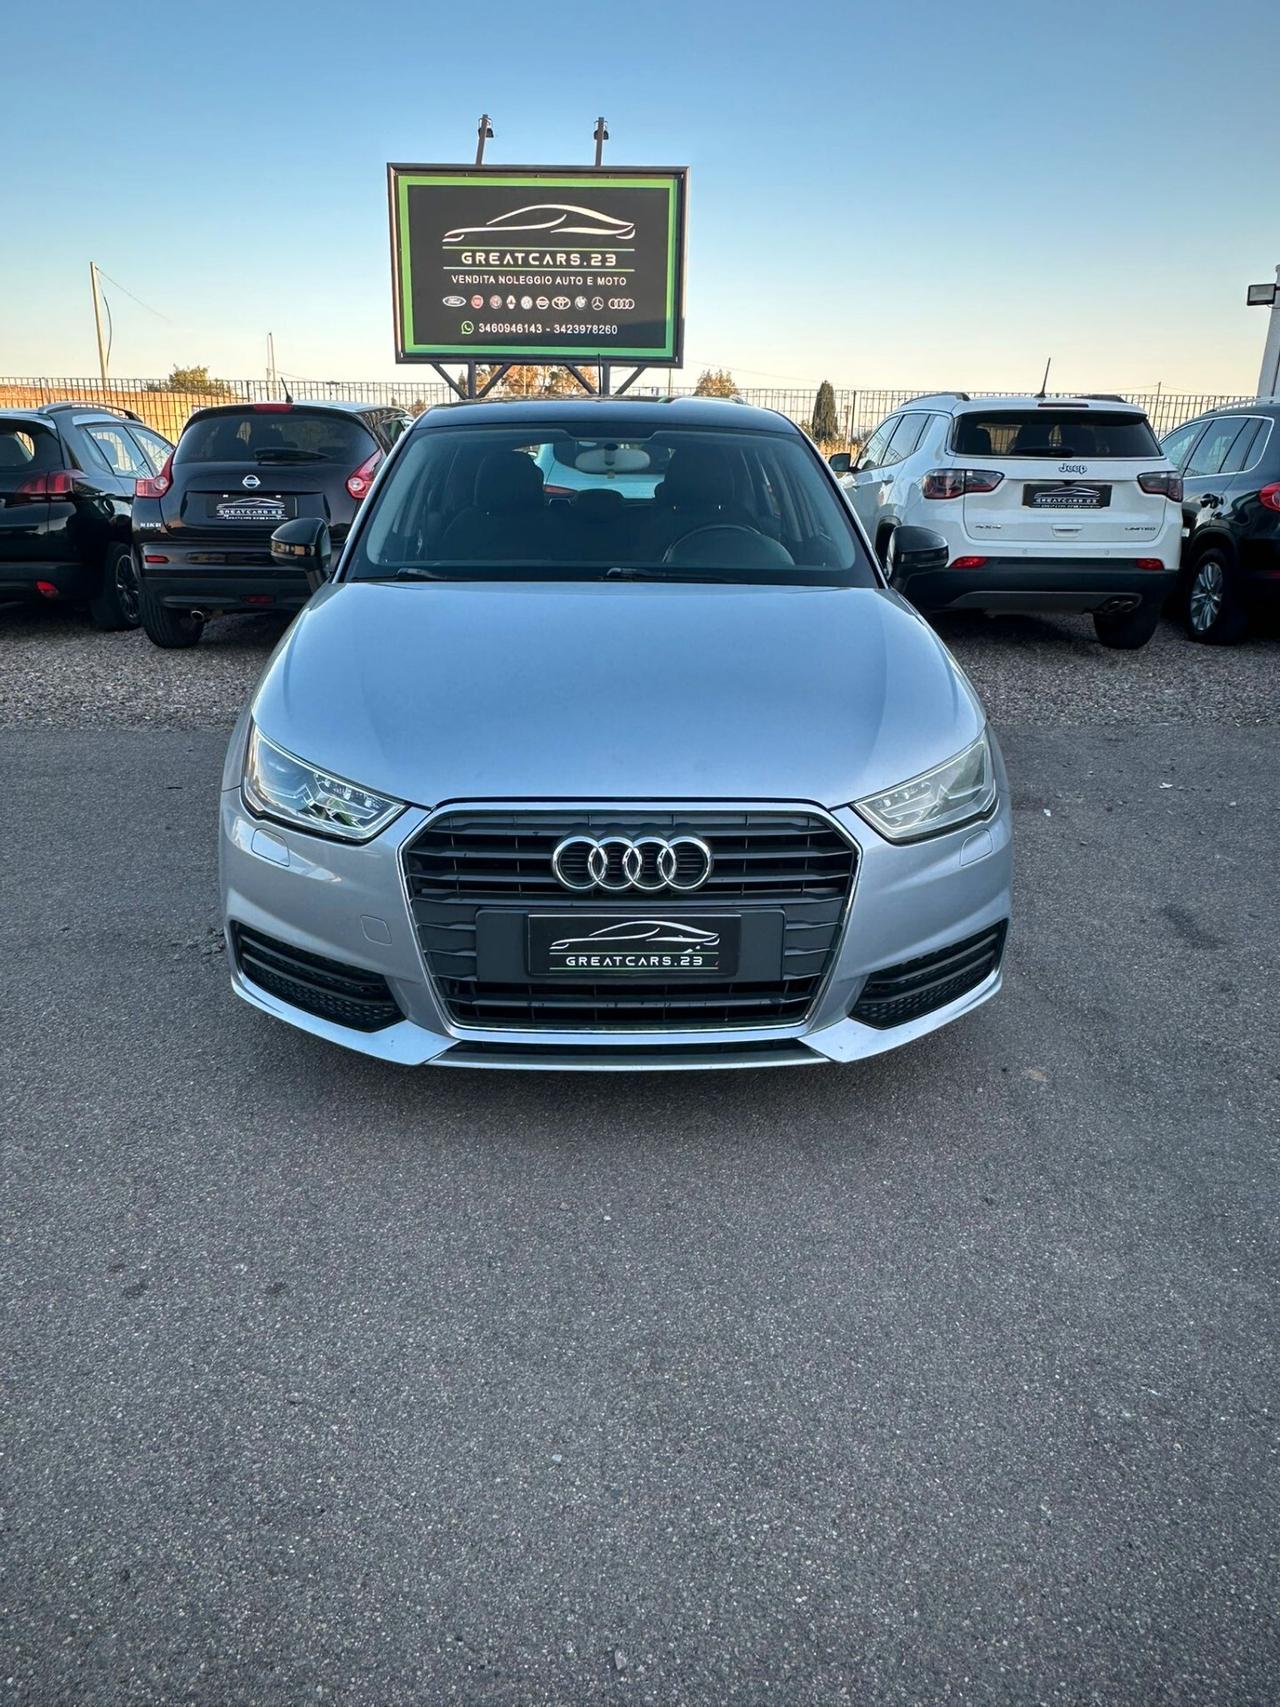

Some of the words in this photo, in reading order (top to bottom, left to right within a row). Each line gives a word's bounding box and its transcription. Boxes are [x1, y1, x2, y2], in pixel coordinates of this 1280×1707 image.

[461, 252, 617, 266] GREATCARS.23
[451, 275, 496, 284] VENDITA
[498, 275, 552, 285] NOLEGGIO
[555, 277, 584, 285] AUTO
[587, 277, 593, 285] E
[597, 278, 627, 286] MOTO
[478, 323, 543, 334] 3460946143
[553, 324, 618, 335] 3423978260
[1058, 463, 1088, 475] Jeep
[566, 956, 703, 966] GREATCARS.23
